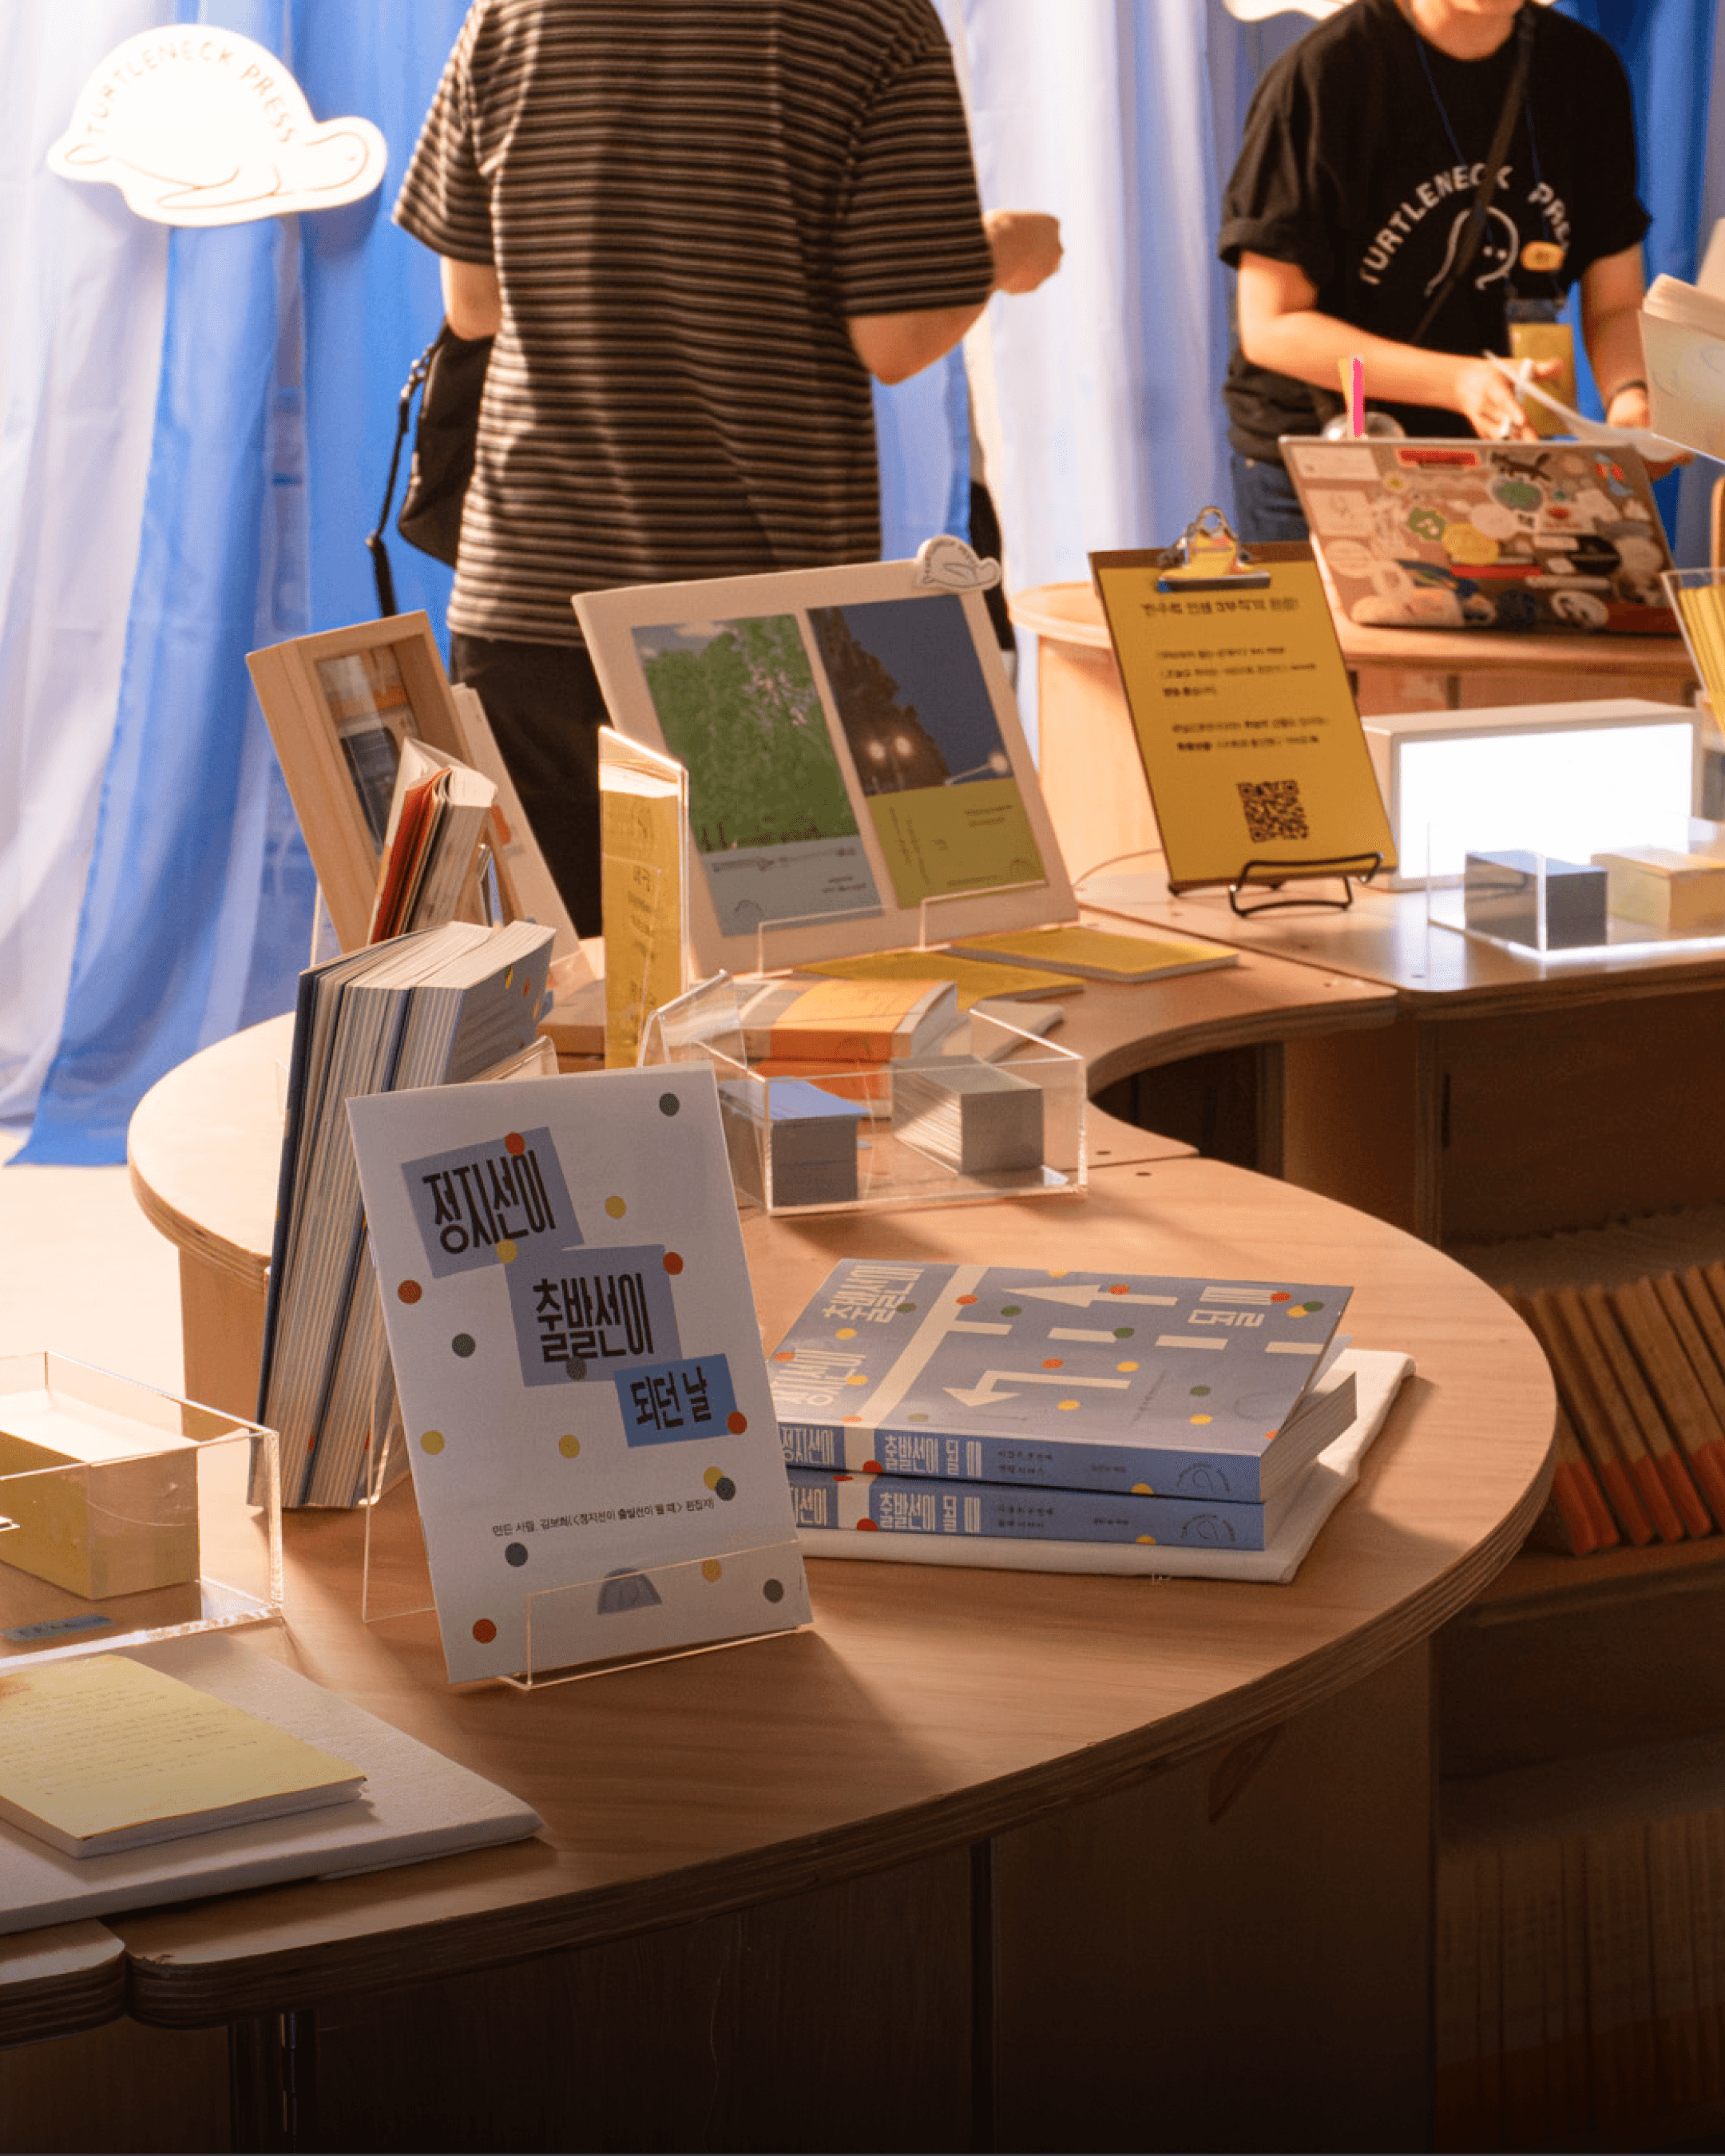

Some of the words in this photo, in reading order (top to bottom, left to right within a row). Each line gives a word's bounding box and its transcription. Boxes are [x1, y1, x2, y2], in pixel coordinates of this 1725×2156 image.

[85, 40, 235, 135] TURTLENECK
[240, 63, 299, 143] PRESS
[422, 1150, 557, 1254] 정지선이
[533, 1273, 655, 1363] 출발선이
[629, 1370, 684, 1431] 되던
[682, 1365, 713, 1423] 날
[781, 1426, 835, 1465] 정지선이
[884, 1435, 940, 1474] 출발선이
[946, 1439, 959, 1476] 될
[879, 1492, 936, 1532] 출발선이
[942, 1495, 957, 1532] 될
